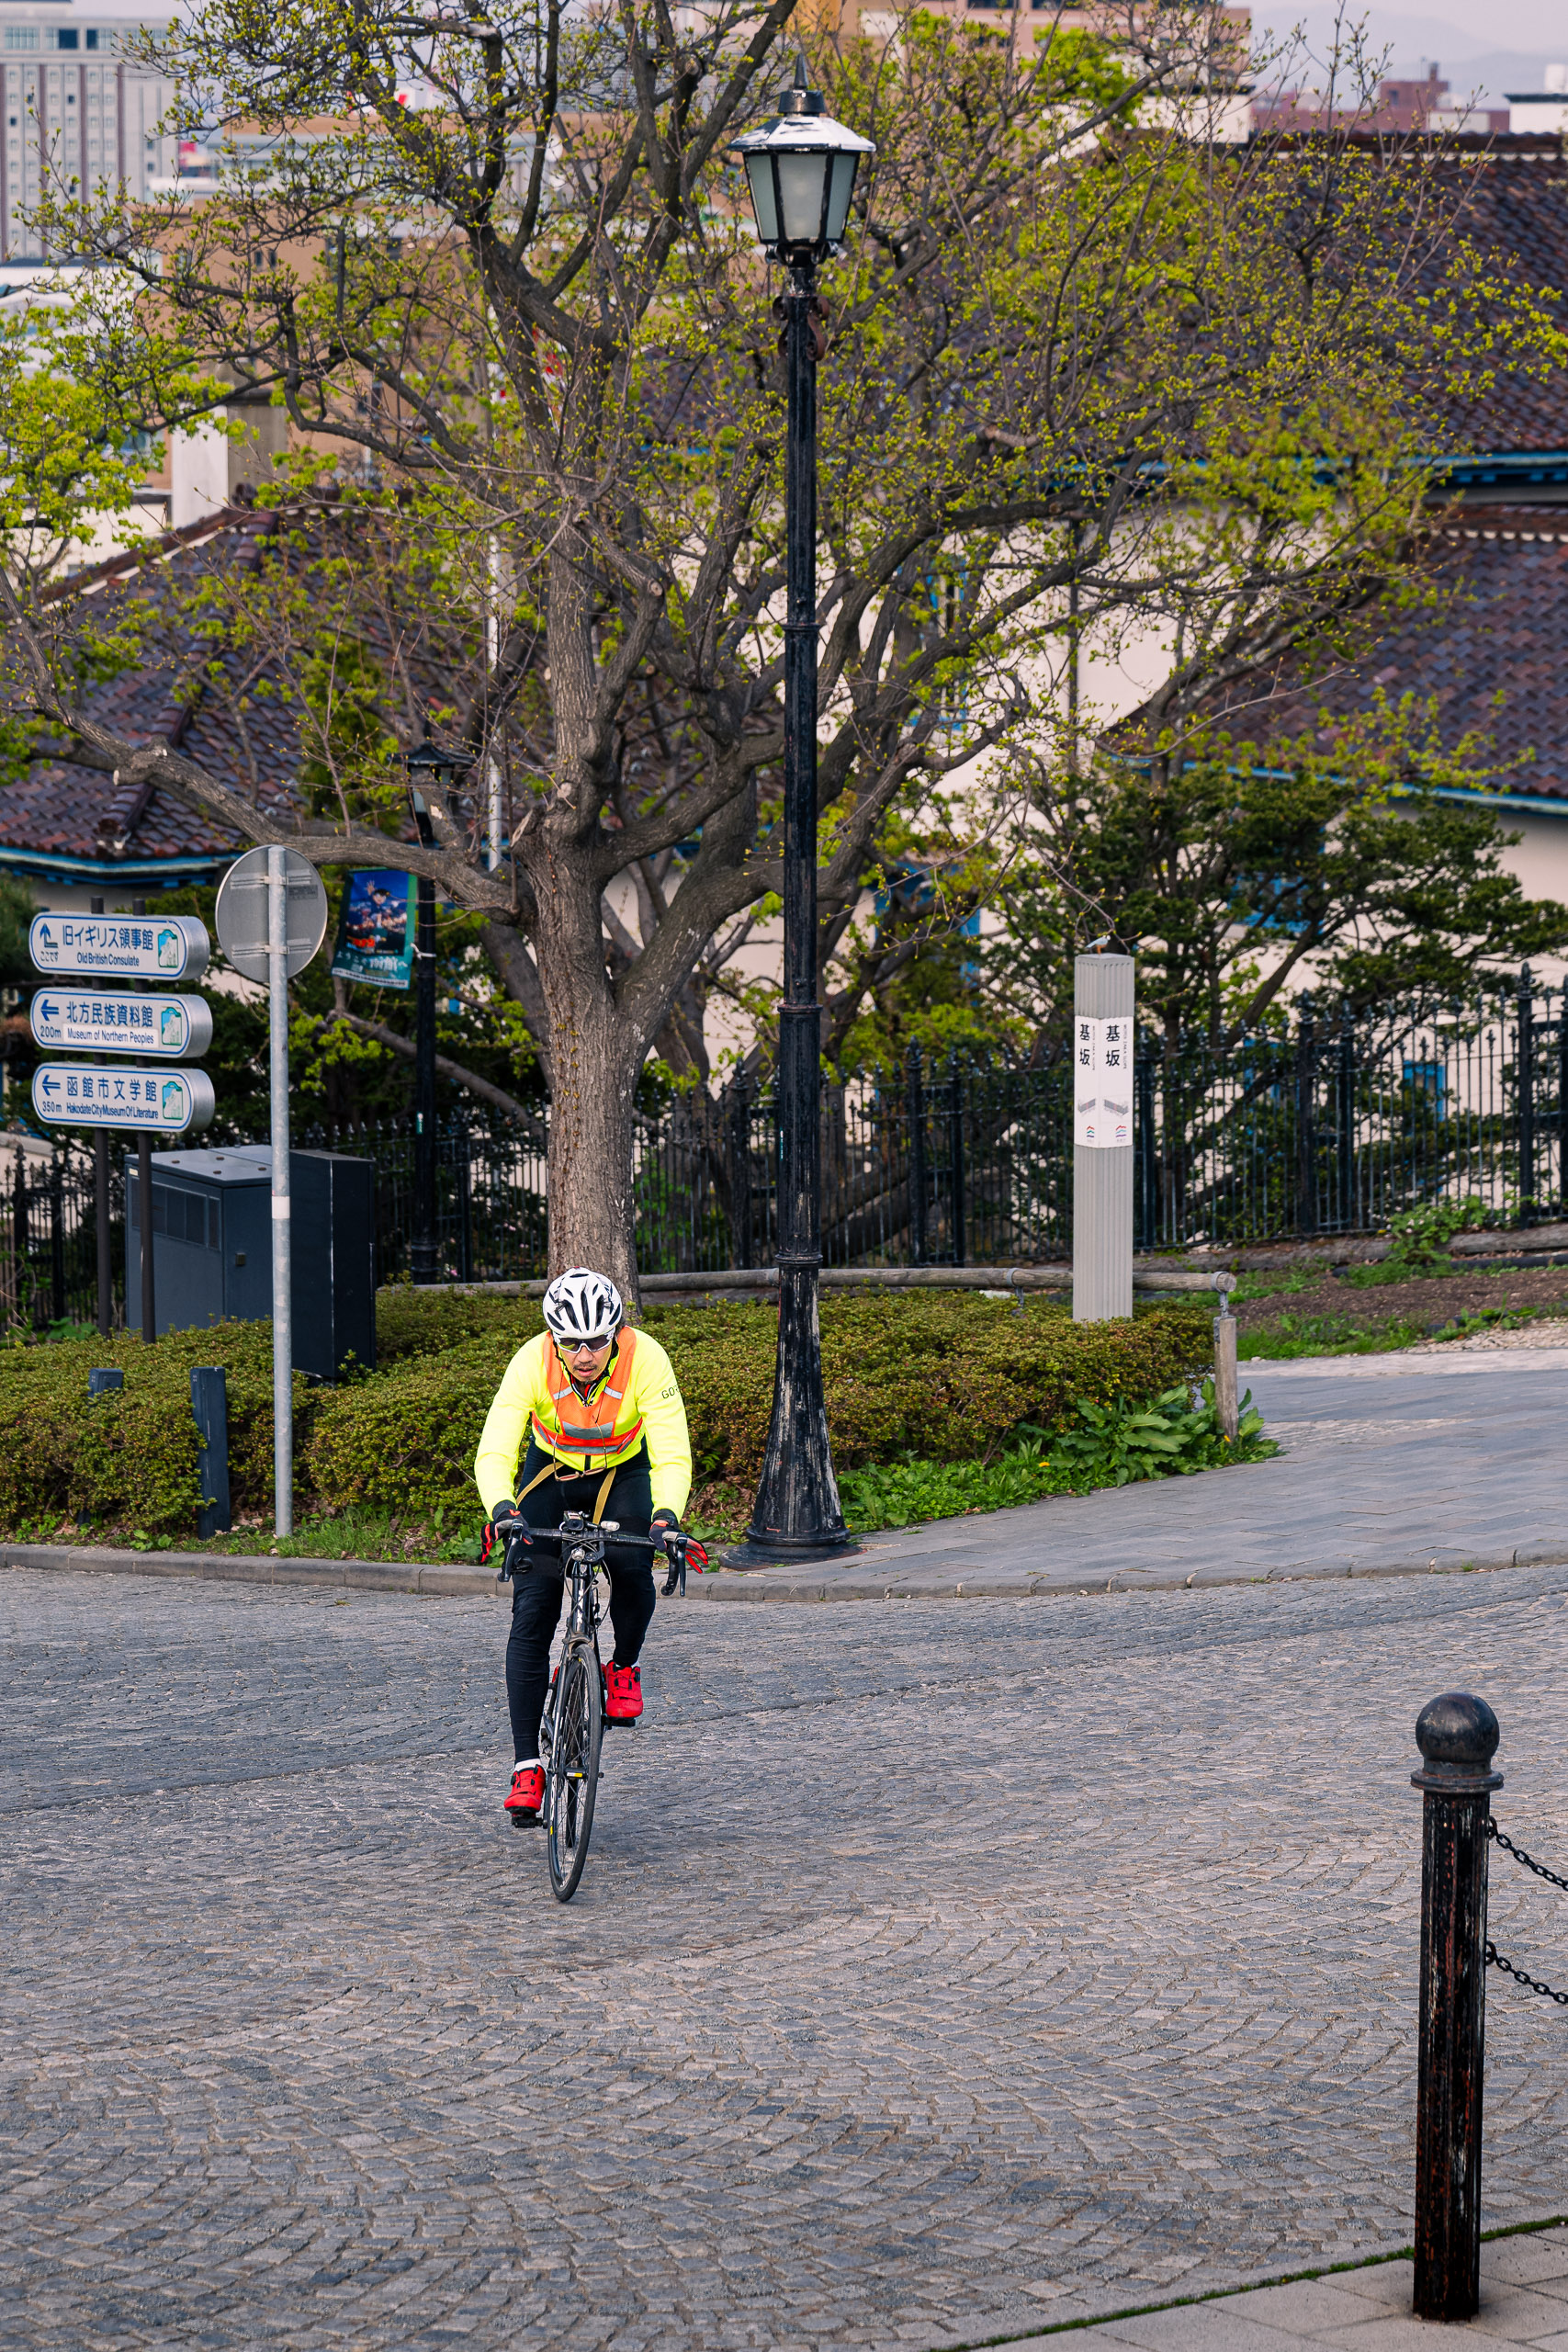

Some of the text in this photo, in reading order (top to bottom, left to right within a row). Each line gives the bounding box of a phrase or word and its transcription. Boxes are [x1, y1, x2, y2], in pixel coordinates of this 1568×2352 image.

[62, 924, 153, 951] 旧イギリス領事館
[40, 951, 59, 963] ここです
[77, 952, 140, 967] Old British Consulate
[66, 1001, 153, 1028] 北方民族資料館
[40, 1025, 62, 1038] 200m
[67, 1027, 154, 1046] Museum of Northern Peoples
[1079, 1023, 1090, 1067] 基坂
[1106, 1024, 1121, 1067] 基坂
[66, 1076, 157, 1102] 函館市文学館
[42, 1101, 62, 1113] 350m
[66, 1102, 159, 1119] Hakodate City Museum Of Literature
